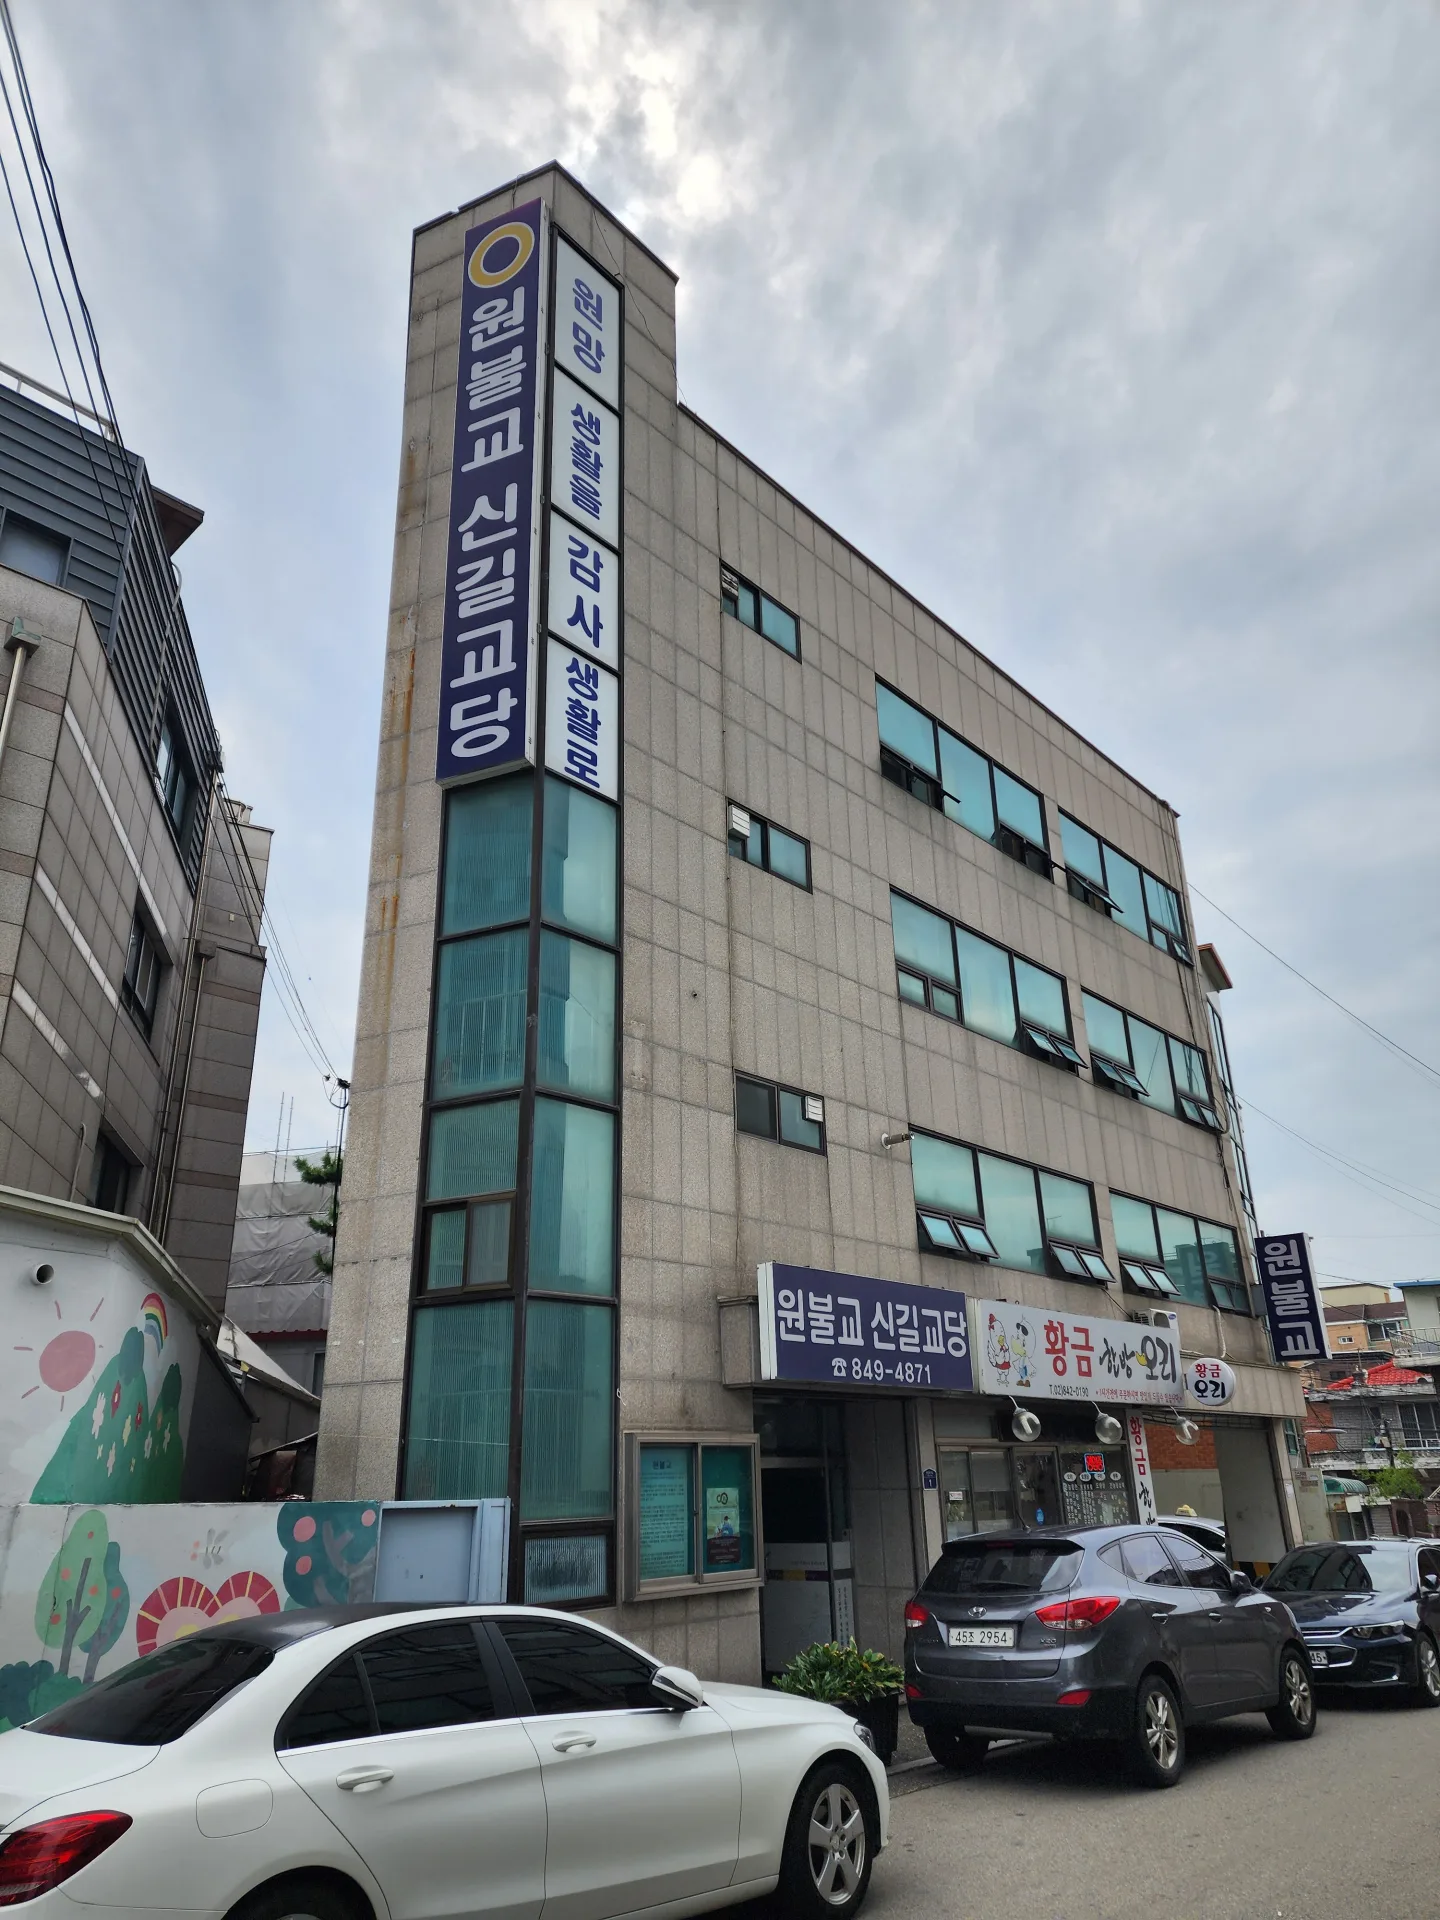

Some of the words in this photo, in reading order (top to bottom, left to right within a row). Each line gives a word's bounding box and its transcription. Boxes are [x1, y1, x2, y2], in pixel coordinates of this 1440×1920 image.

[572, 278, 606, 374] 원망
[460, 286, 527, 473] 원불교
[569, 403, 604, 521] 생활을
[449, 482, 518, 758] 신길교당
[567, 534, 604, 649] 감사
[565, 657, 602, 789] 생활로
[777, 1289, 865, 1346] 원불교
[870, 1301, 967, 1358] 신길교당
[1264, 1239, 1320, 1357] 원불교
[851, 1357, 931, 1384] 849-4871
[1044, 1319, 1095, 1378] 황금
[1099, 1337, 1136, 1379] 한방
[1140, 1335, 1177, 1384] 오리
[1194, 1379, 1226, 1399] 오리
[1195, 1363, 1221, 1378] 황금
[1130, 1416, 1146, 1476] 황금
[955, 1631, 975, 1644] 45조
[979, 1630, 1007, 1644] 2954
